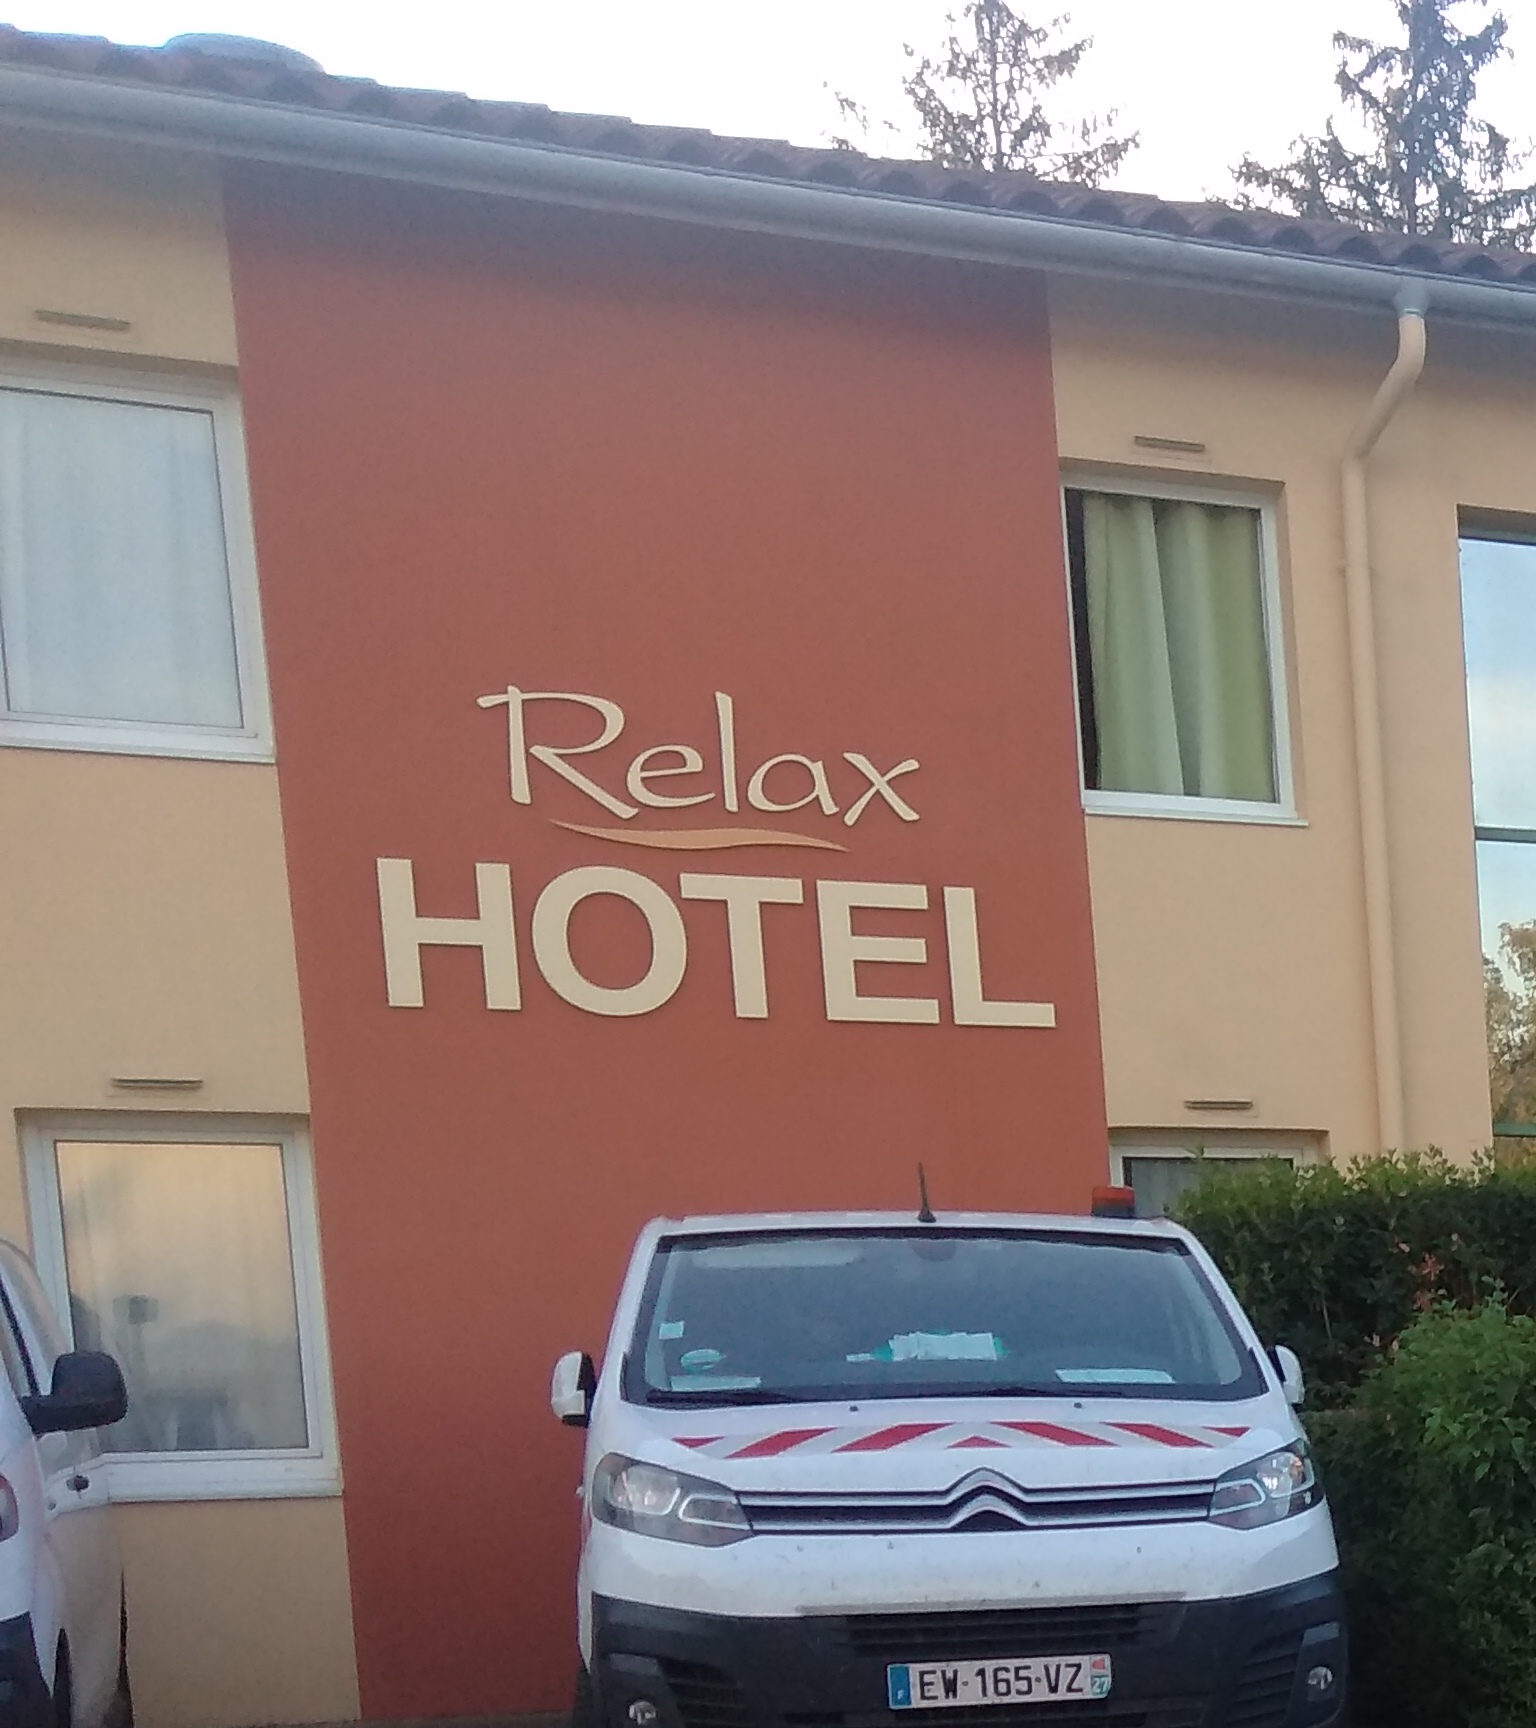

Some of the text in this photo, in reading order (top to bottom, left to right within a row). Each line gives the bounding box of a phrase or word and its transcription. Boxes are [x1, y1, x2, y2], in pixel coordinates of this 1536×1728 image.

[476, 685, 920, 826] Relax
[376, 857, 1057, 1028] HOTEL
[918, 1663, 1084, 1700] EW-165-VZ
